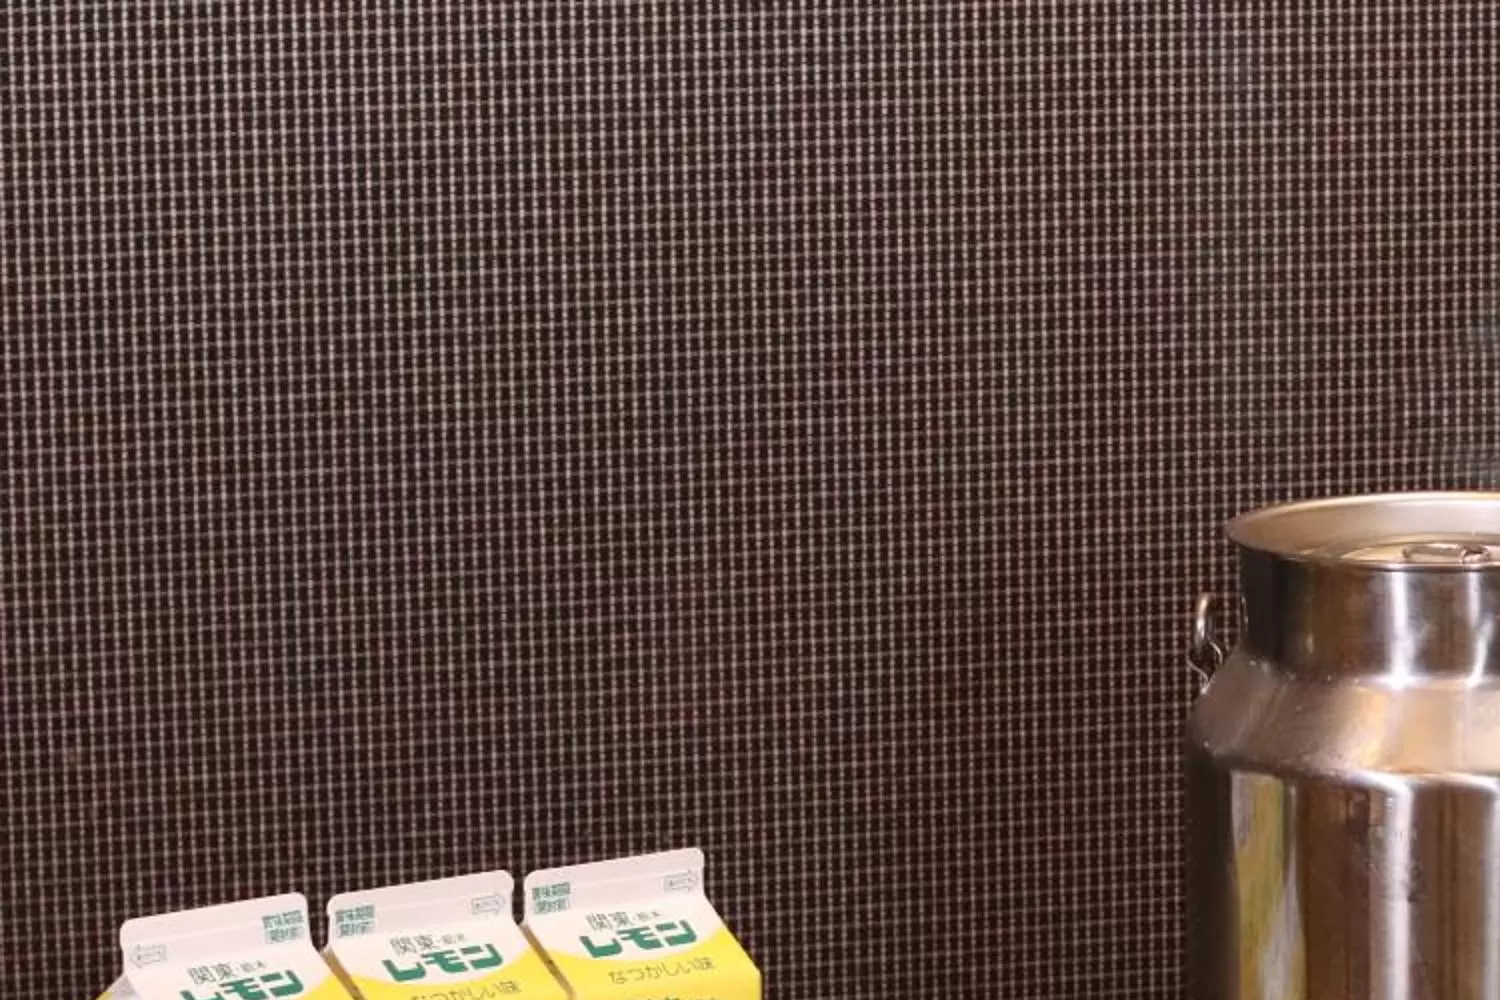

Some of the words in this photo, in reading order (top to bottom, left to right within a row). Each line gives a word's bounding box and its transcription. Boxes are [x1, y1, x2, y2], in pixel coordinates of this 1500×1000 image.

[579, 919, 697, 958] レモン
[382, 943, 503, 982] レモン
